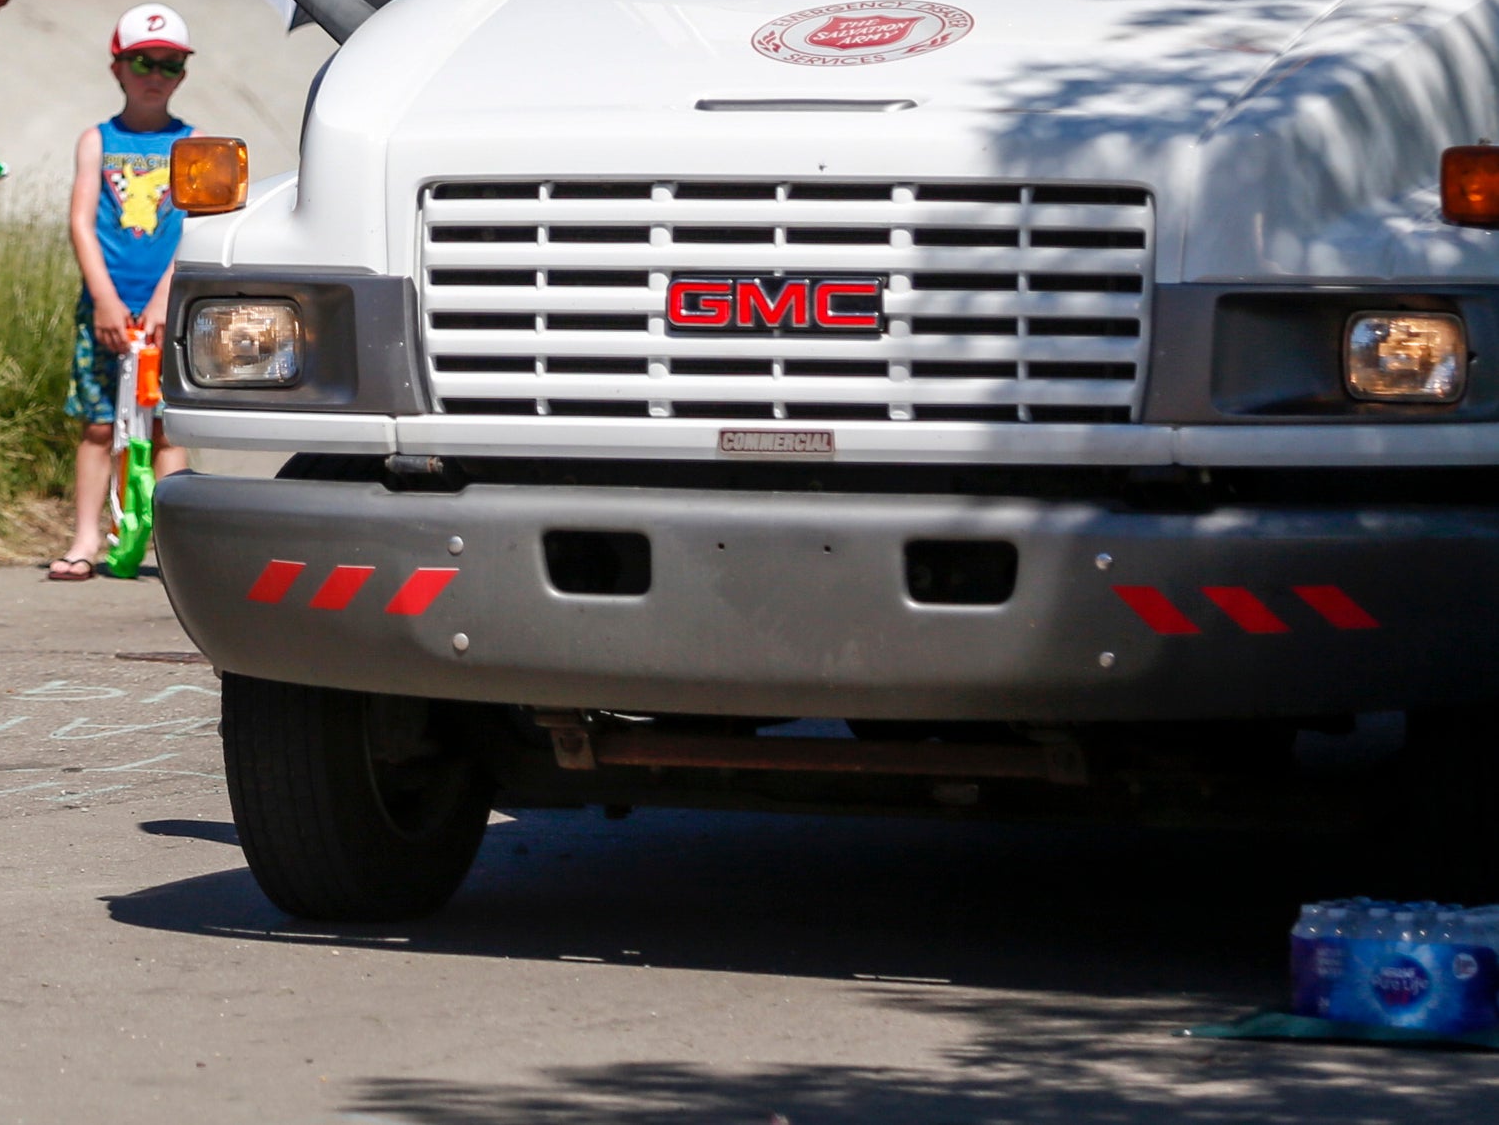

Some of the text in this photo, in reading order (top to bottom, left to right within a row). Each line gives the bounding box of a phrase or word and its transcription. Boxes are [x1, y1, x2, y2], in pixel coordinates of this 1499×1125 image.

[772, 1, 968, 28] EMERGENCY DISASTER
[812, 21, 910, 41] SALVATION
[838, 18, 880, 30] THE
[835, 30, 900, 46] ARMY
[783, 54, 887, 66] SERVICES
[102, 153, 170, 170] PIKACH
[667, 278, 879, 328] GMC
[721, 432, 832, 452] COMMERCIAL
